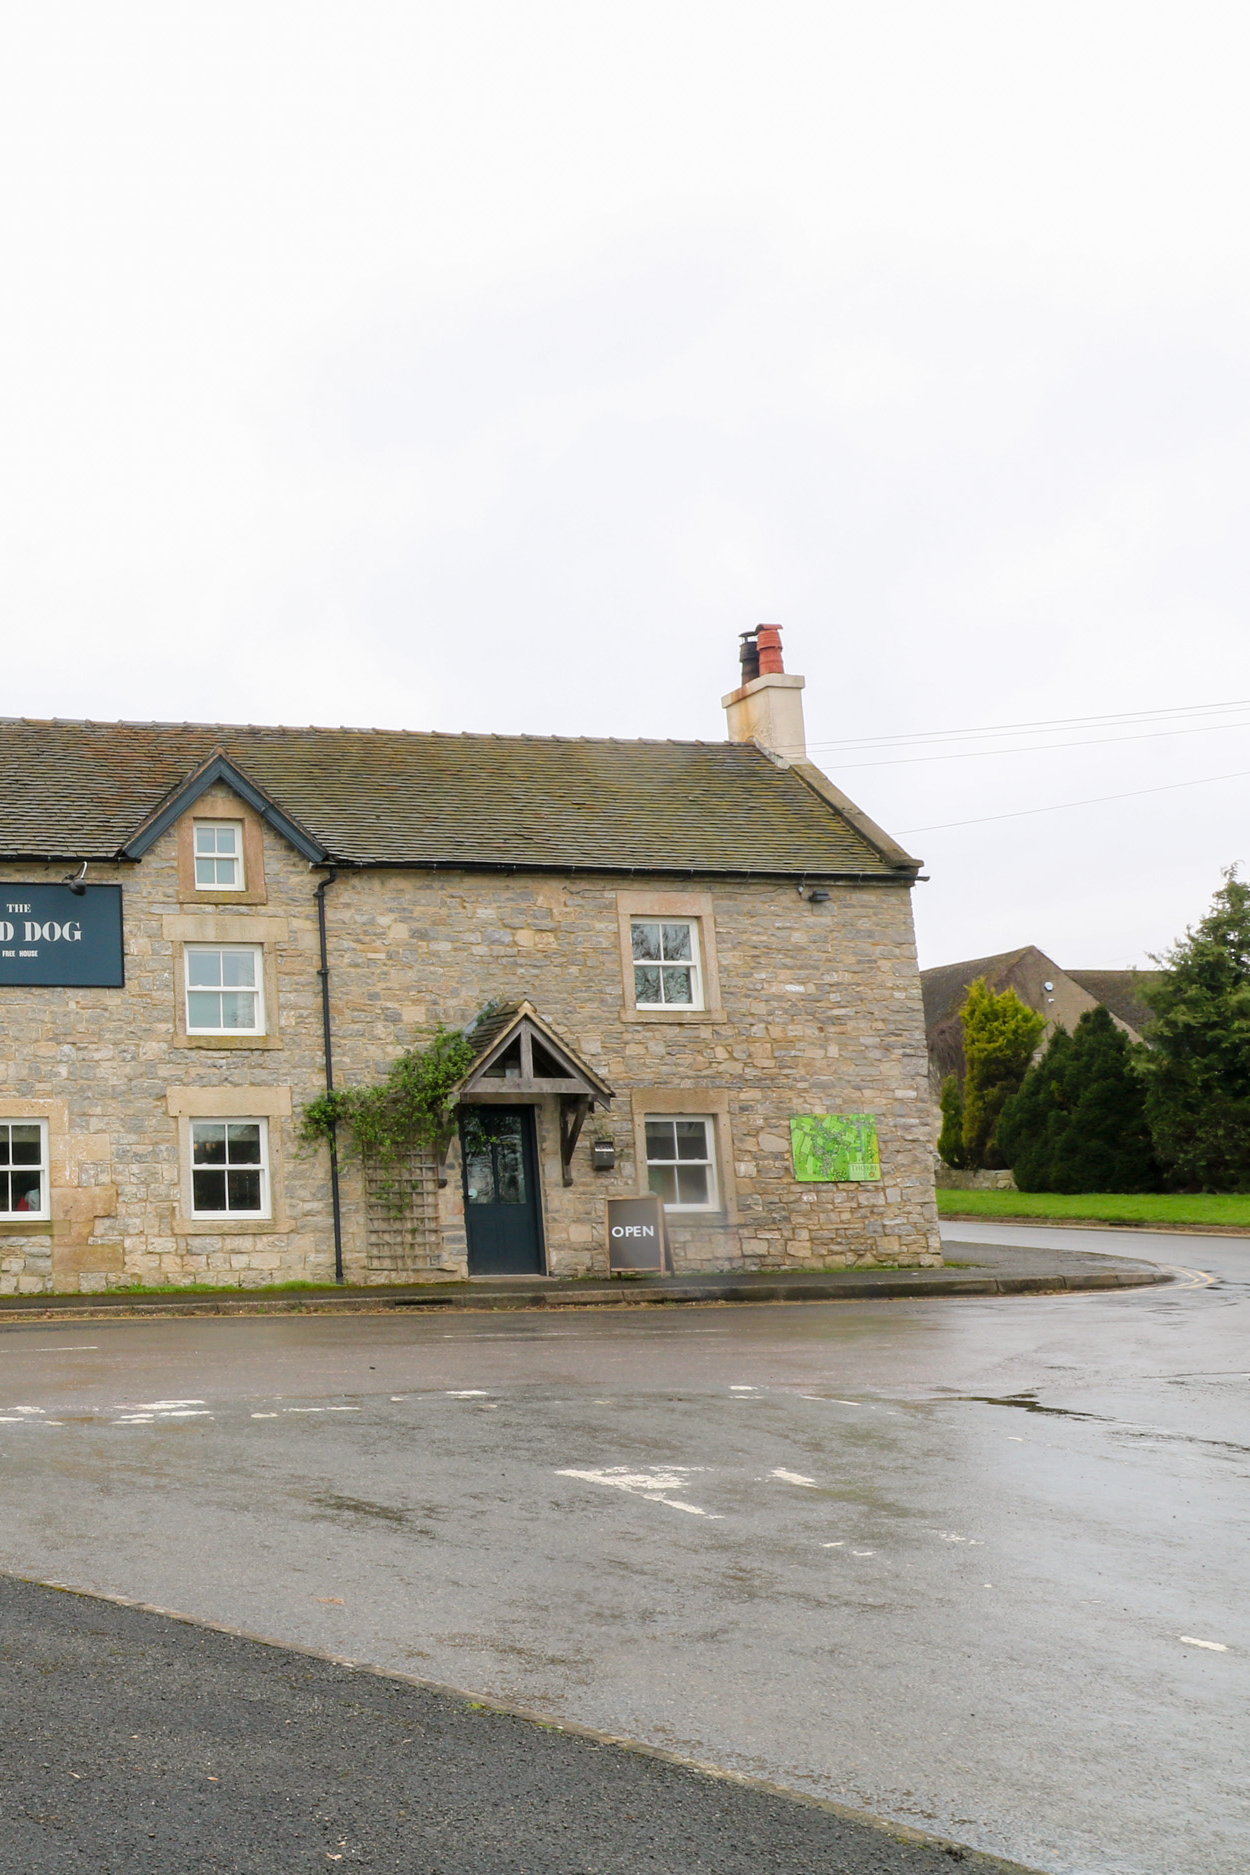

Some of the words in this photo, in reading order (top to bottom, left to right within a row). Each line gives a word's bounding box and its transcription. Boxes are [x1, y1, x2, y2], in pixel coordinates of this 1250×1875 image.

[6, 903, 32, 913] THE
[23, 921, 83, 941] DOG
[611, 1225, 654, 1238] OPEN
